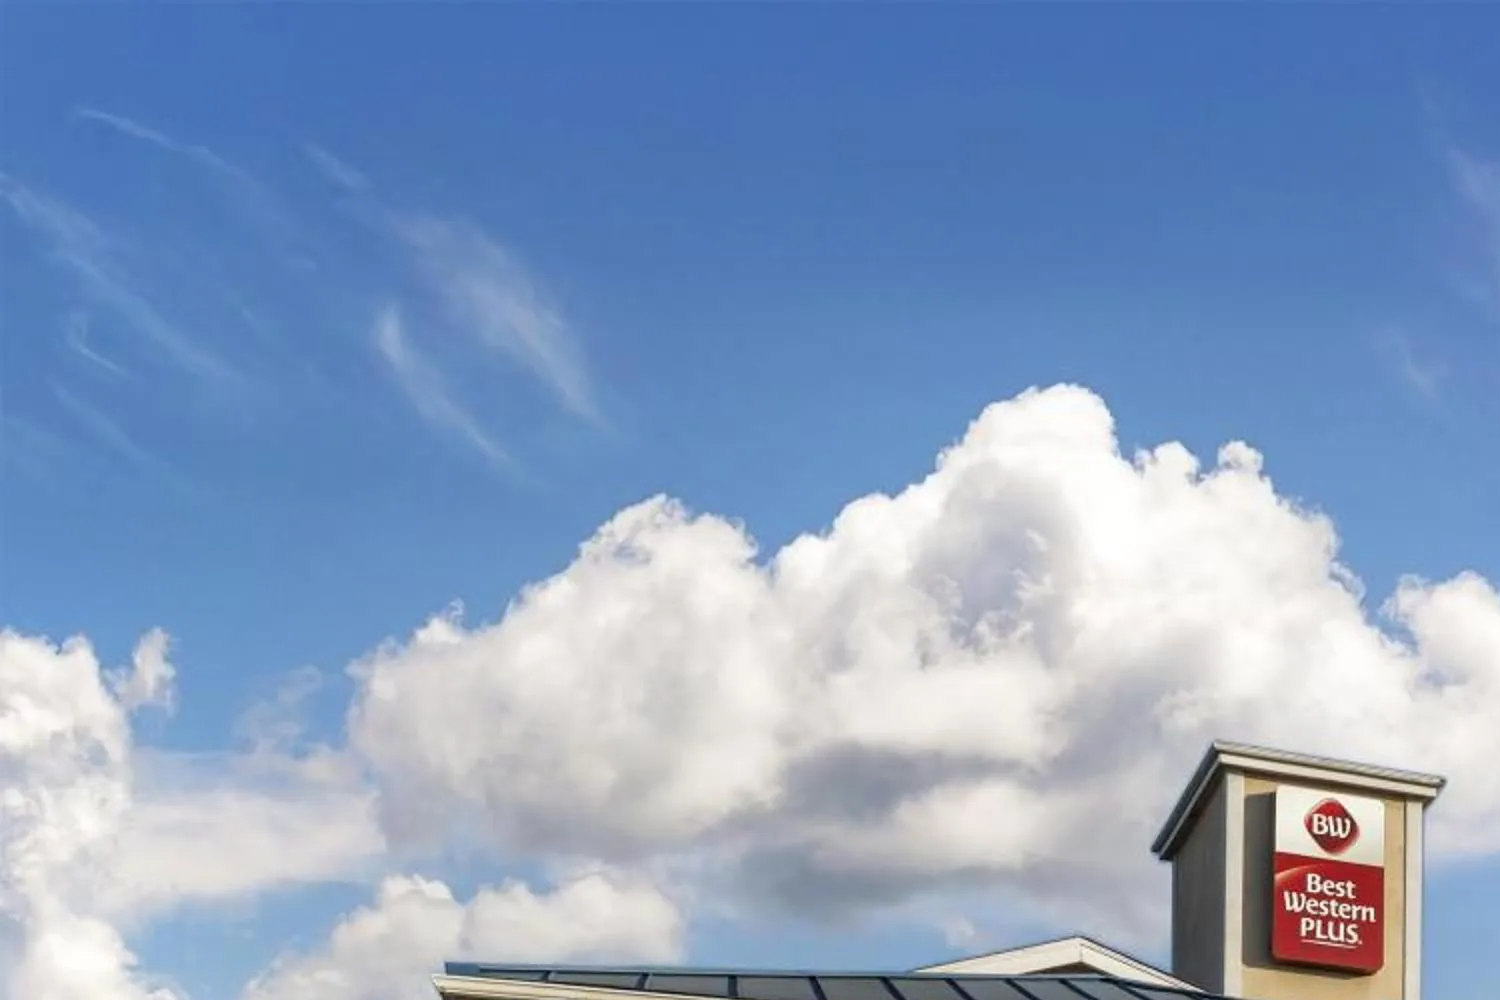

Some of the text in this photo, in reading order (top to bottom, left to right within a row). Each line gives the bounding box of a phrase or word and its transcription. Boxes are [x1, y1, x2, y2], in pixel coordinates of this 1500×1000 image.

[1312, 813, 1350, 838] BW
[1307, 873, 1356, 899] Best
[1283, 891, 1376, 922] Western
